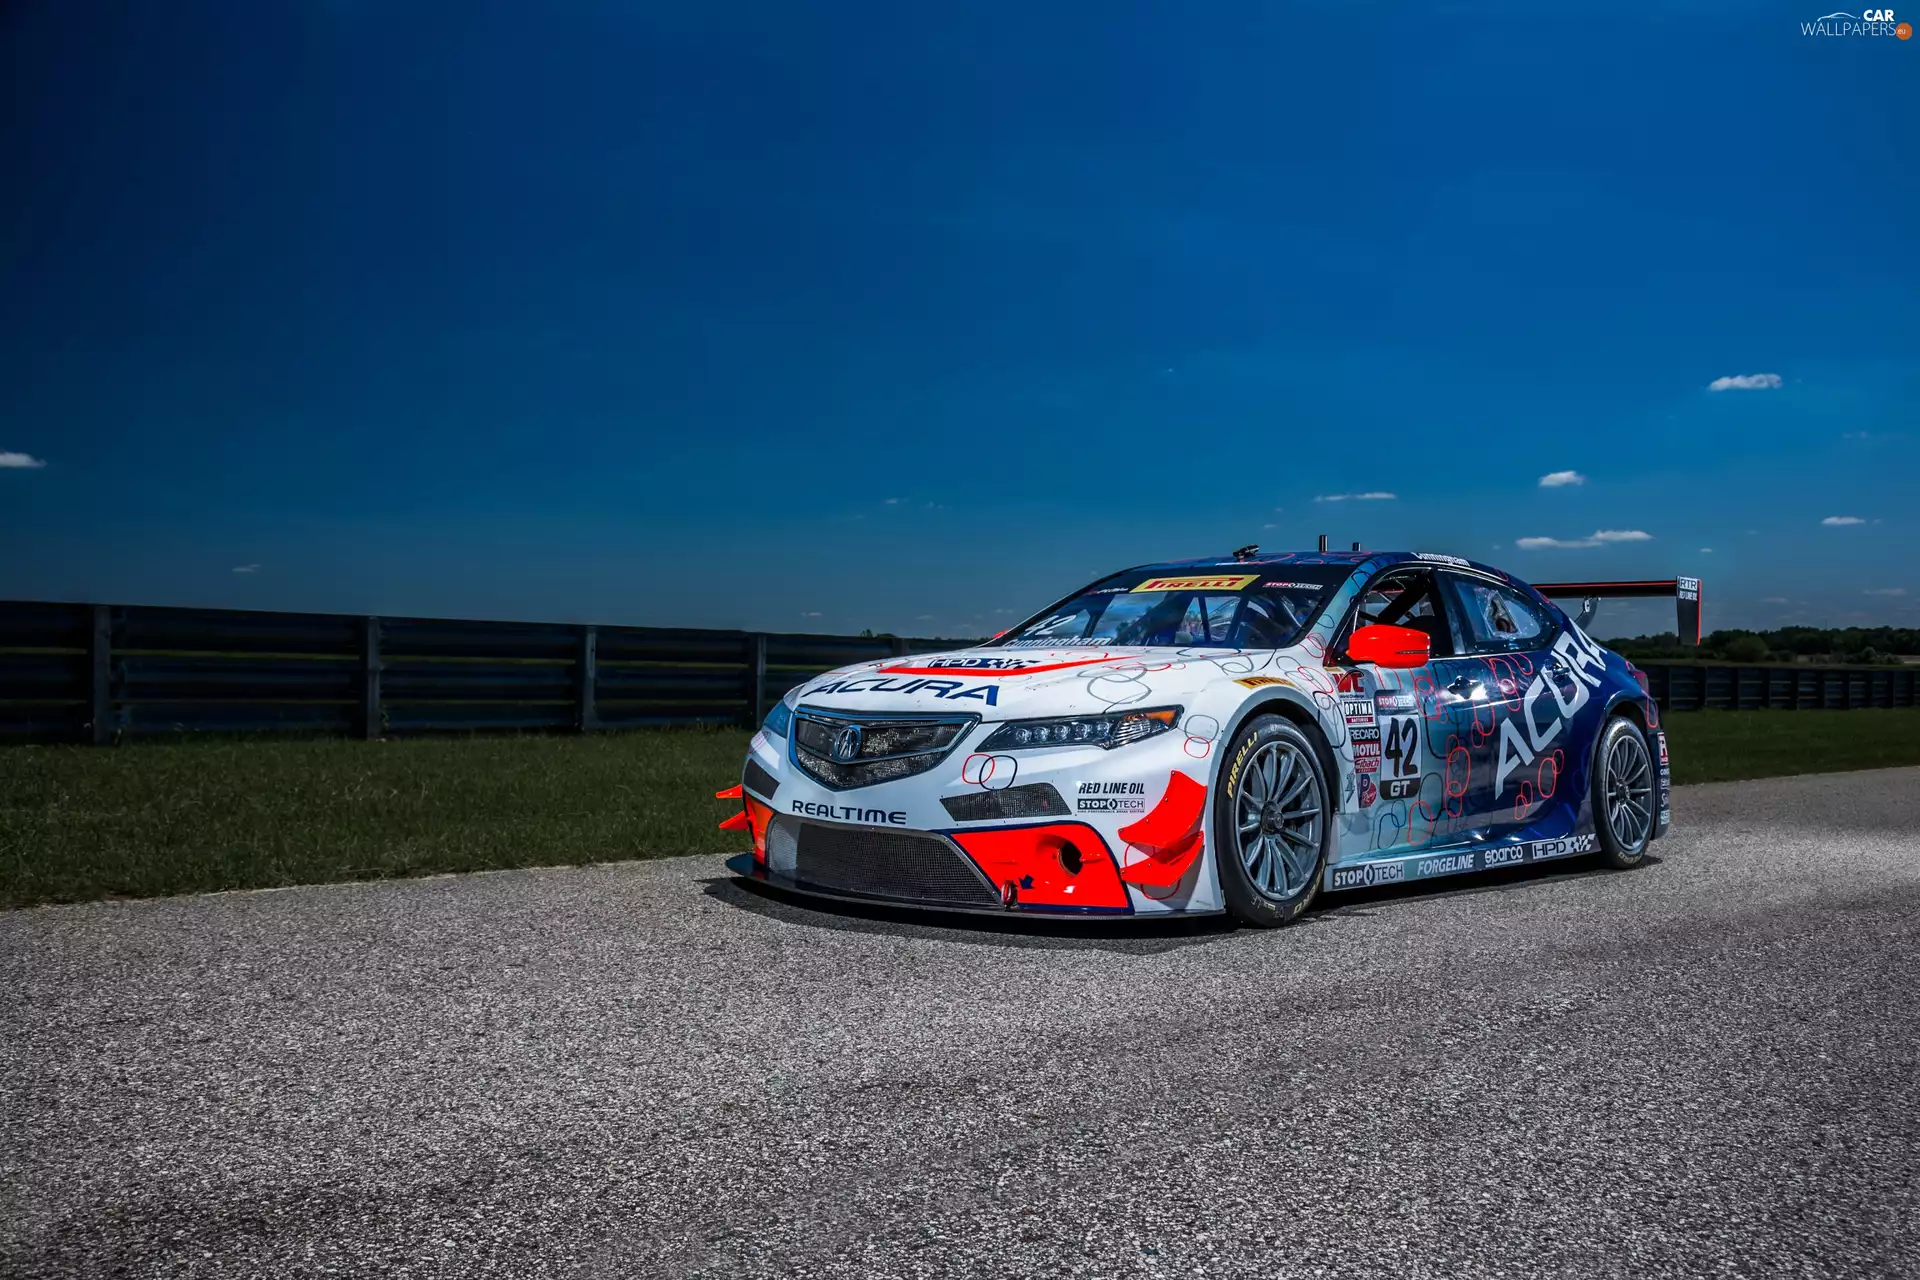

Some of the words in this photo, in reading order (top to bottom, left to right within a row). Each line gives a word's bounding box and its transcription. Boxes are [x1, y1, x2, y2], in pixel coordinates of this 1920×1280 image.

[1144, 577, 1245, 590] PIRELLI
[1680, 579, 1697, 592] RTR
[930, 657, 982, 669] HPD
[801, 678, 1000, 707] ACURA
[1345, 702, 1373, 715] OPTIMA
[1495, 617, 1608, 801] ACURA
[1350, 728, 1380, 740] RECARO
[1352, 743, 1380, 757] MOTUL
[1384, 717, 1419, 778] 42
[1227, 732, 1259, 799] PIRELLI
[1079, 782, 1101, 794] RED
[1102, 782, 1128, 794] LINE
[1129, 782, 1145, 794] OIL
[1390, 780, 1410, 797] GT
[792, 800, 907, 825] REALTIME
[1417, 854, 1475, 876] FORGELINE
[1484, 845, 1524, 865] sparco
[1534, 840, 1567, 859] HPD
